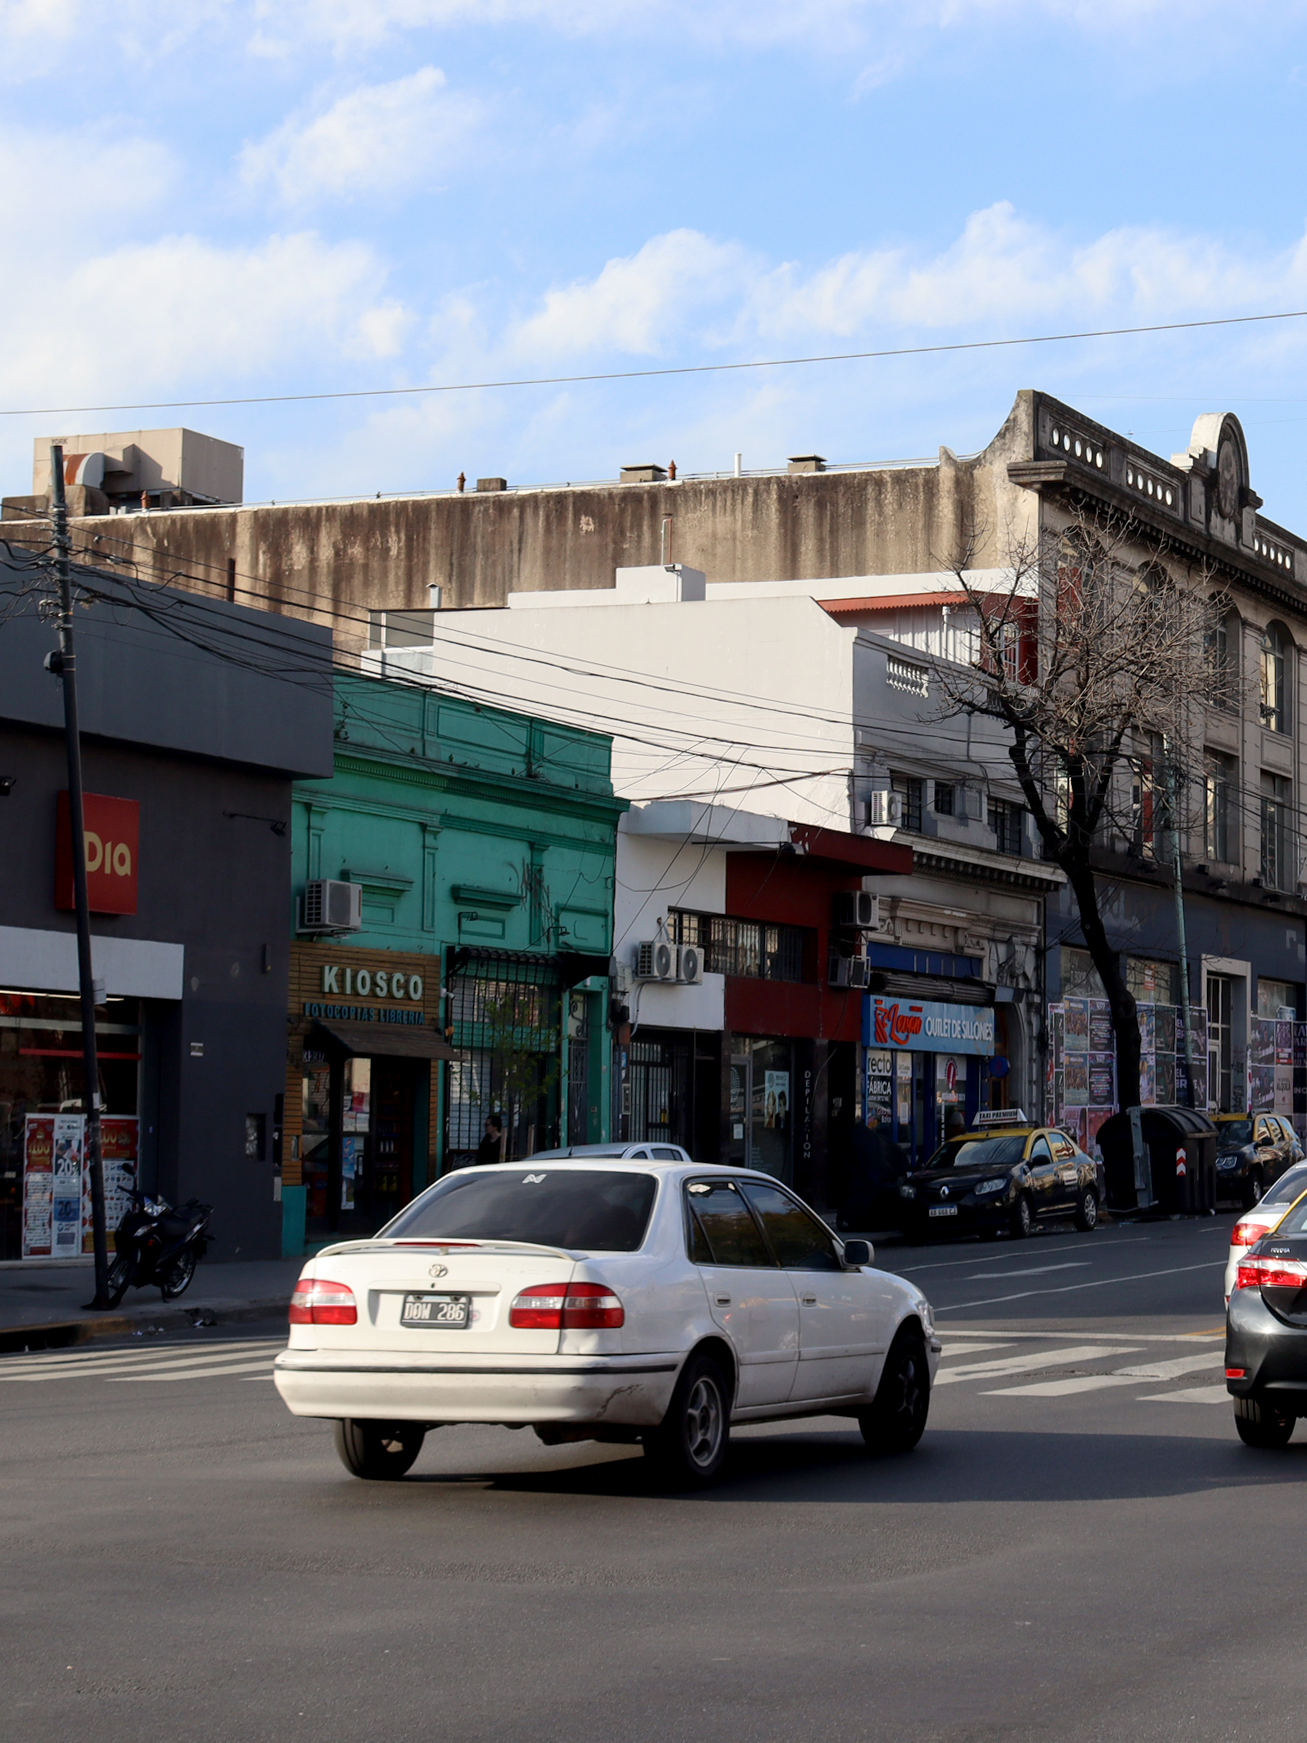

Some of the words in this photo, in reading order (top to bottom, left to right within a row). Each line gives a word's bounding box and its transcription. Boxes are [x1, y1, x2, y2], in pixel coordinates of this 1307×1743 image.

[321, 965, 424, 1001] KIOSCO
[304, 1002, 376, 1022] FOTOCOPIAS
[379, 1010, 426, 1026] LIBRERIA
[925, 1016, 952, 1037] OUTLET
[952, 1020, 961, 1039] DE
[960, 1020, 993, 1042] SILLONES
[979, 1112, 991, 1120] TAXI
[992, 1110, 1018, 1119] PREMIUM
[403, 1302, 432, 1320] DOW
[437, 1303, 465, 1320] 286
